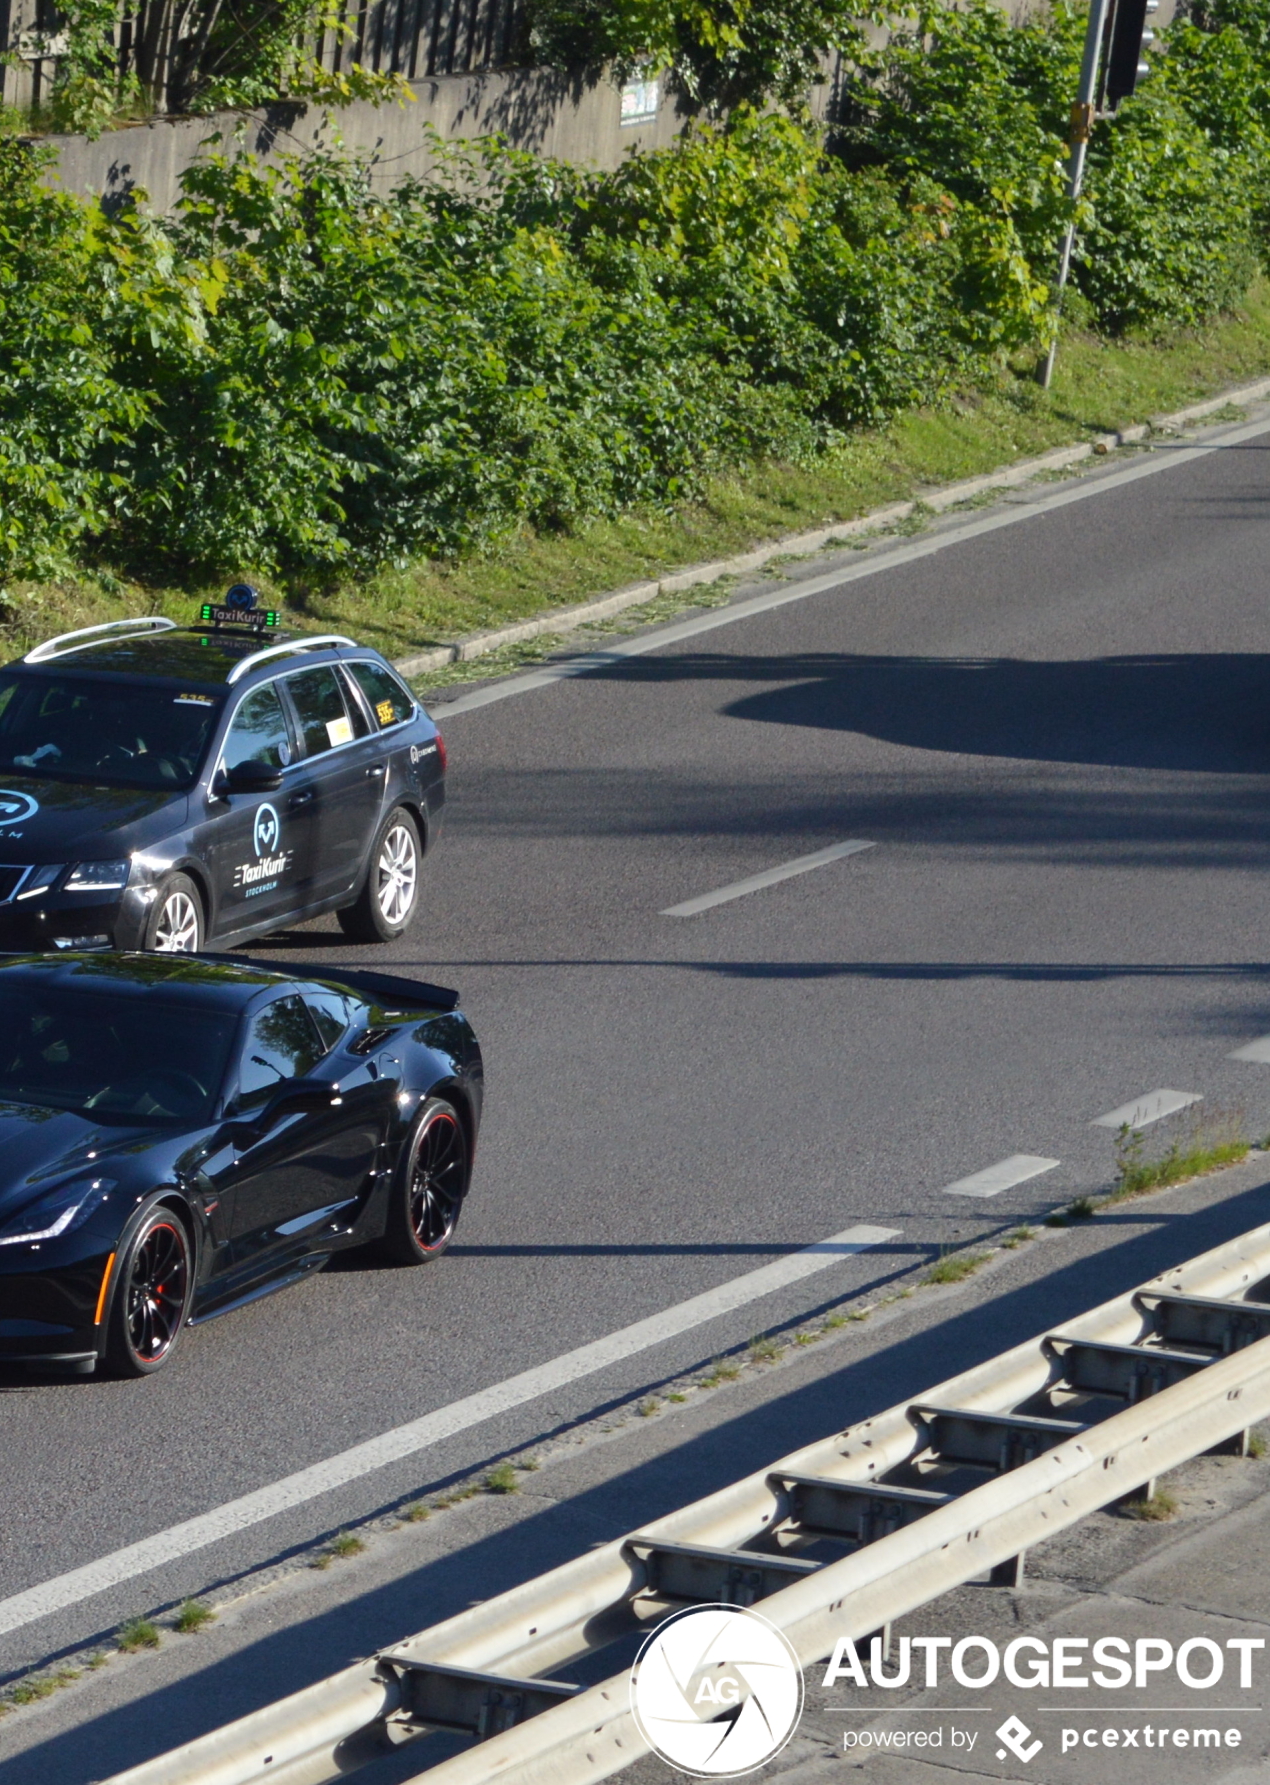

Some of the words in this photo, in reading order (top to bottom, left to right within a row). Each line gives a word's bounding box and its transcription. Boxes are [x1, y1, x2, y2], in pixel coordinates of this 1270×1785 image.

[212, 607, 265, 624] TaxiKurir
[241, 851, 287, 884] TaxiKurir
[245, 880, 278, 898] STOCKHOLM
